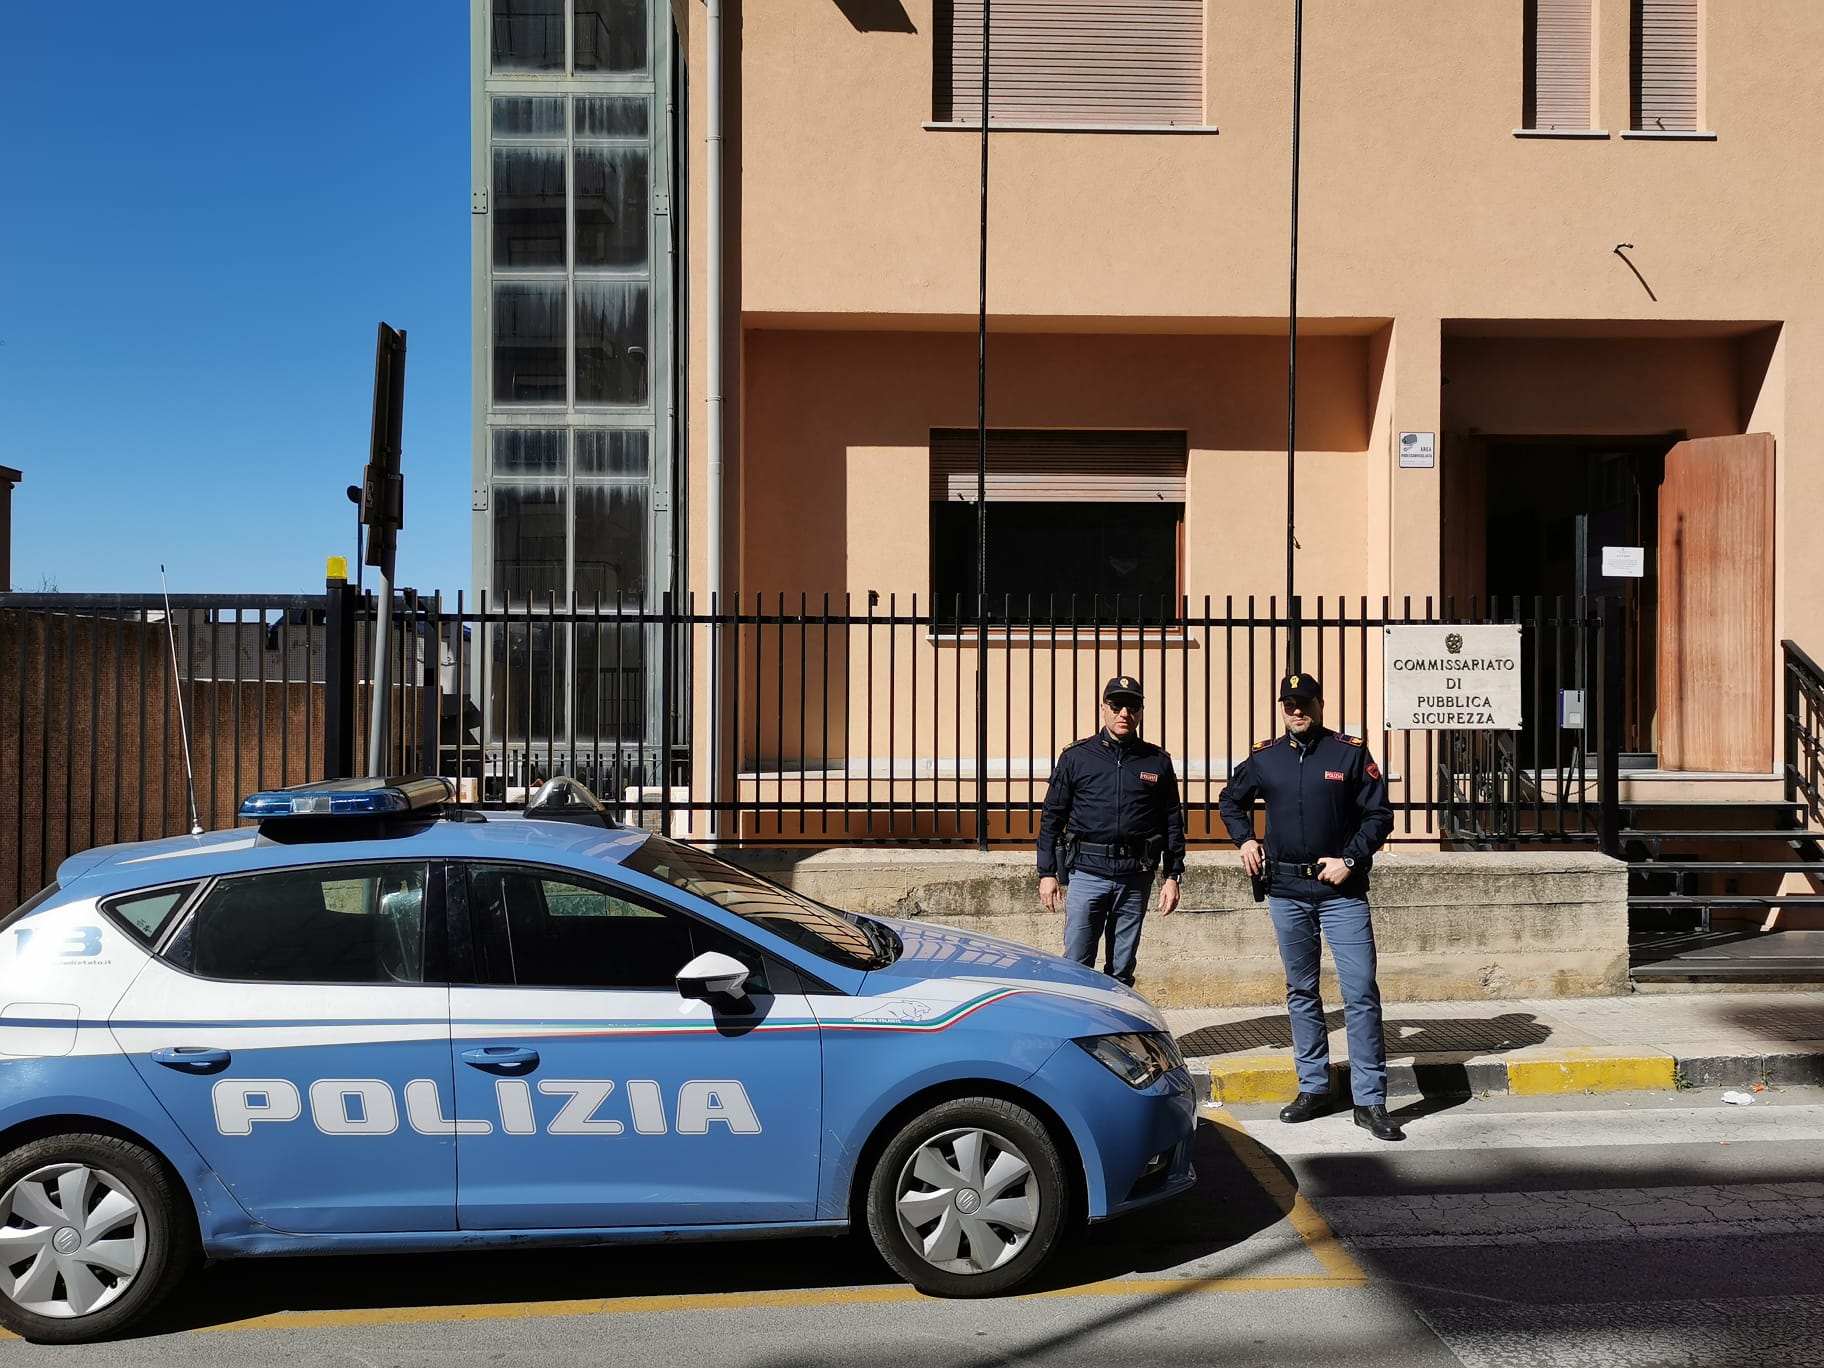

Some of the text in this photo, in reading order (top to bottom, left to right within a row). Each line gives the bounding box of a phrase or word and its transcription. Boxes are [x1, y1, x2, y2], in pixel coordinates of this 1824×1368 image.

[1393, 659, 1515, 671] COMMISSARIATO
[1446, 678, 1462, 690] DI
[1417, 696, 1492, 708] PUBBLICA
[1412, 713, 1496, 725] SICUREZZA
[211, 1078, 762, 1136] POLIZIA
